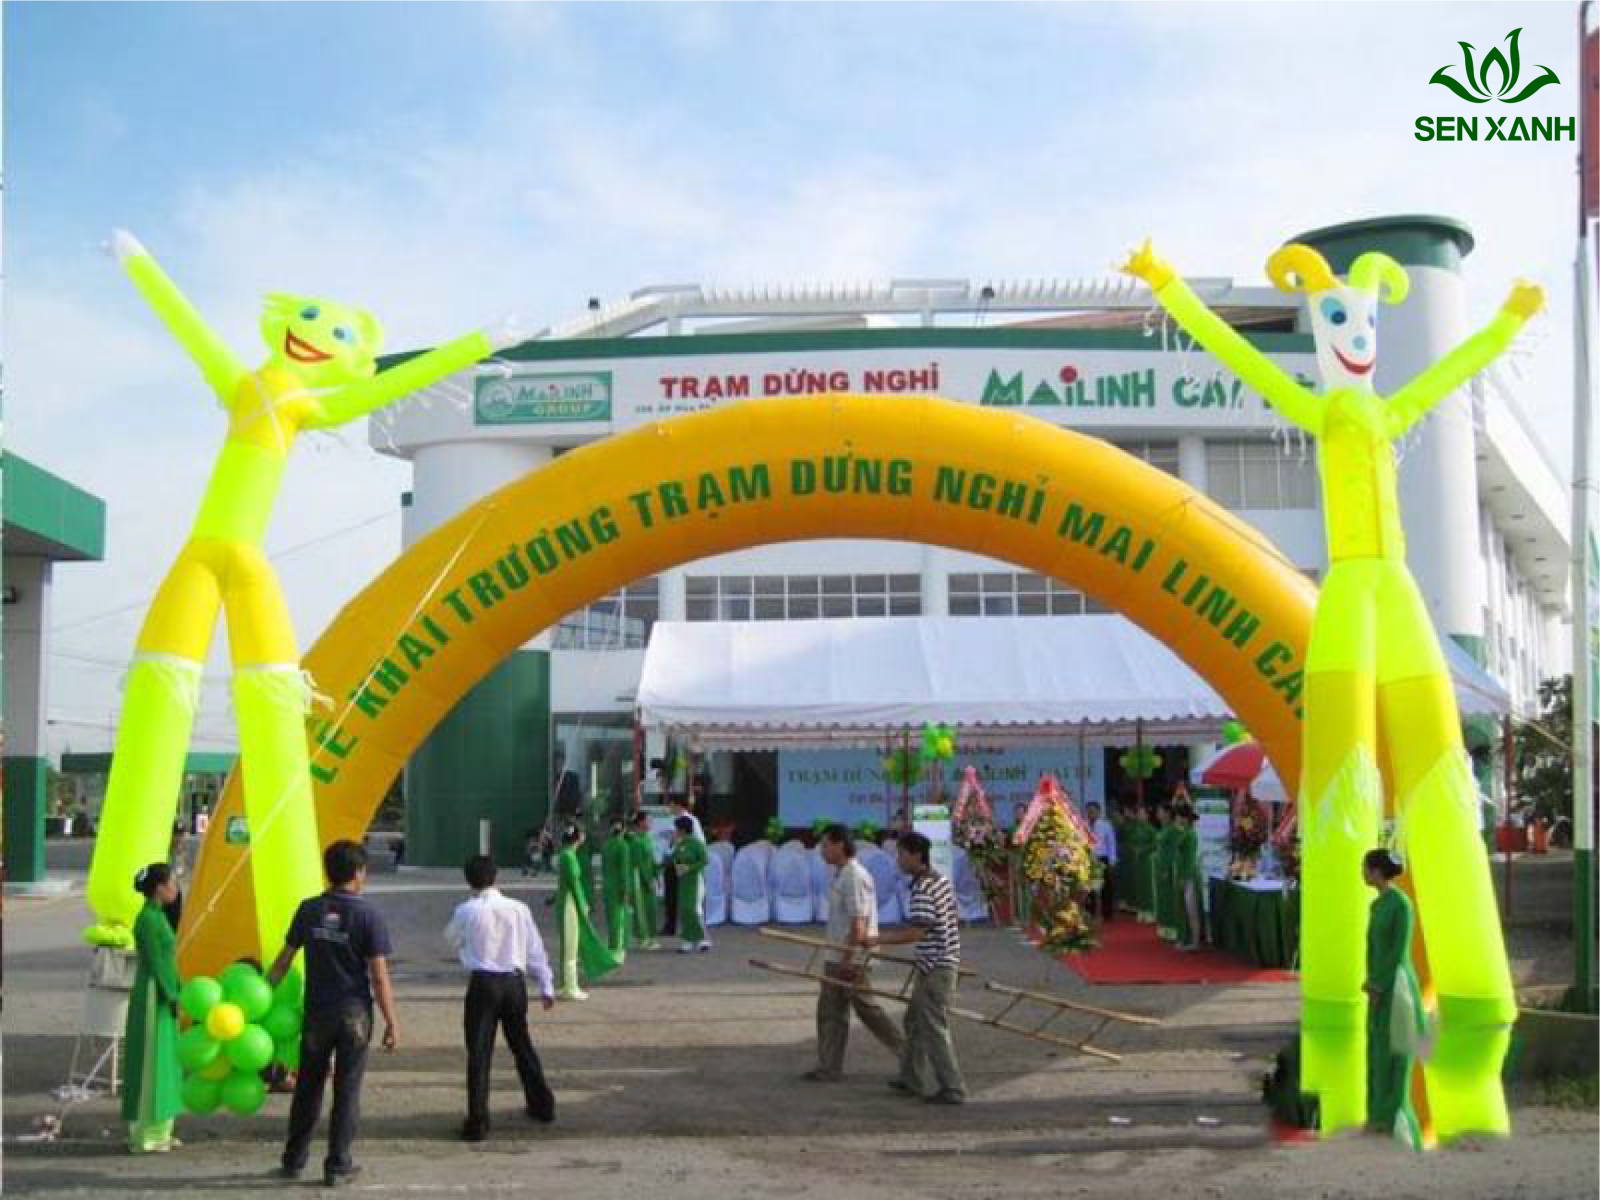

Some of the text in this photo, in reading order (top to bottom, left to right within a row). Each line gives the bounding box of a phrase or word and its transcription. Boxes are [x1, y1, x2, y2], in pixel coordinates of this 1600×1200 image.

[659, 374, 749, 401] TRẠM
[763, 368, 850, 395] DỪNG
[350, 615, 451, 719] KHAI
[628, 463, 771, 529] TRẠM
[1057, 502, 1156, 573] MAI
[1161, 559, 1261, 649] LINH
[1256, 641, 1304, 720] CA
